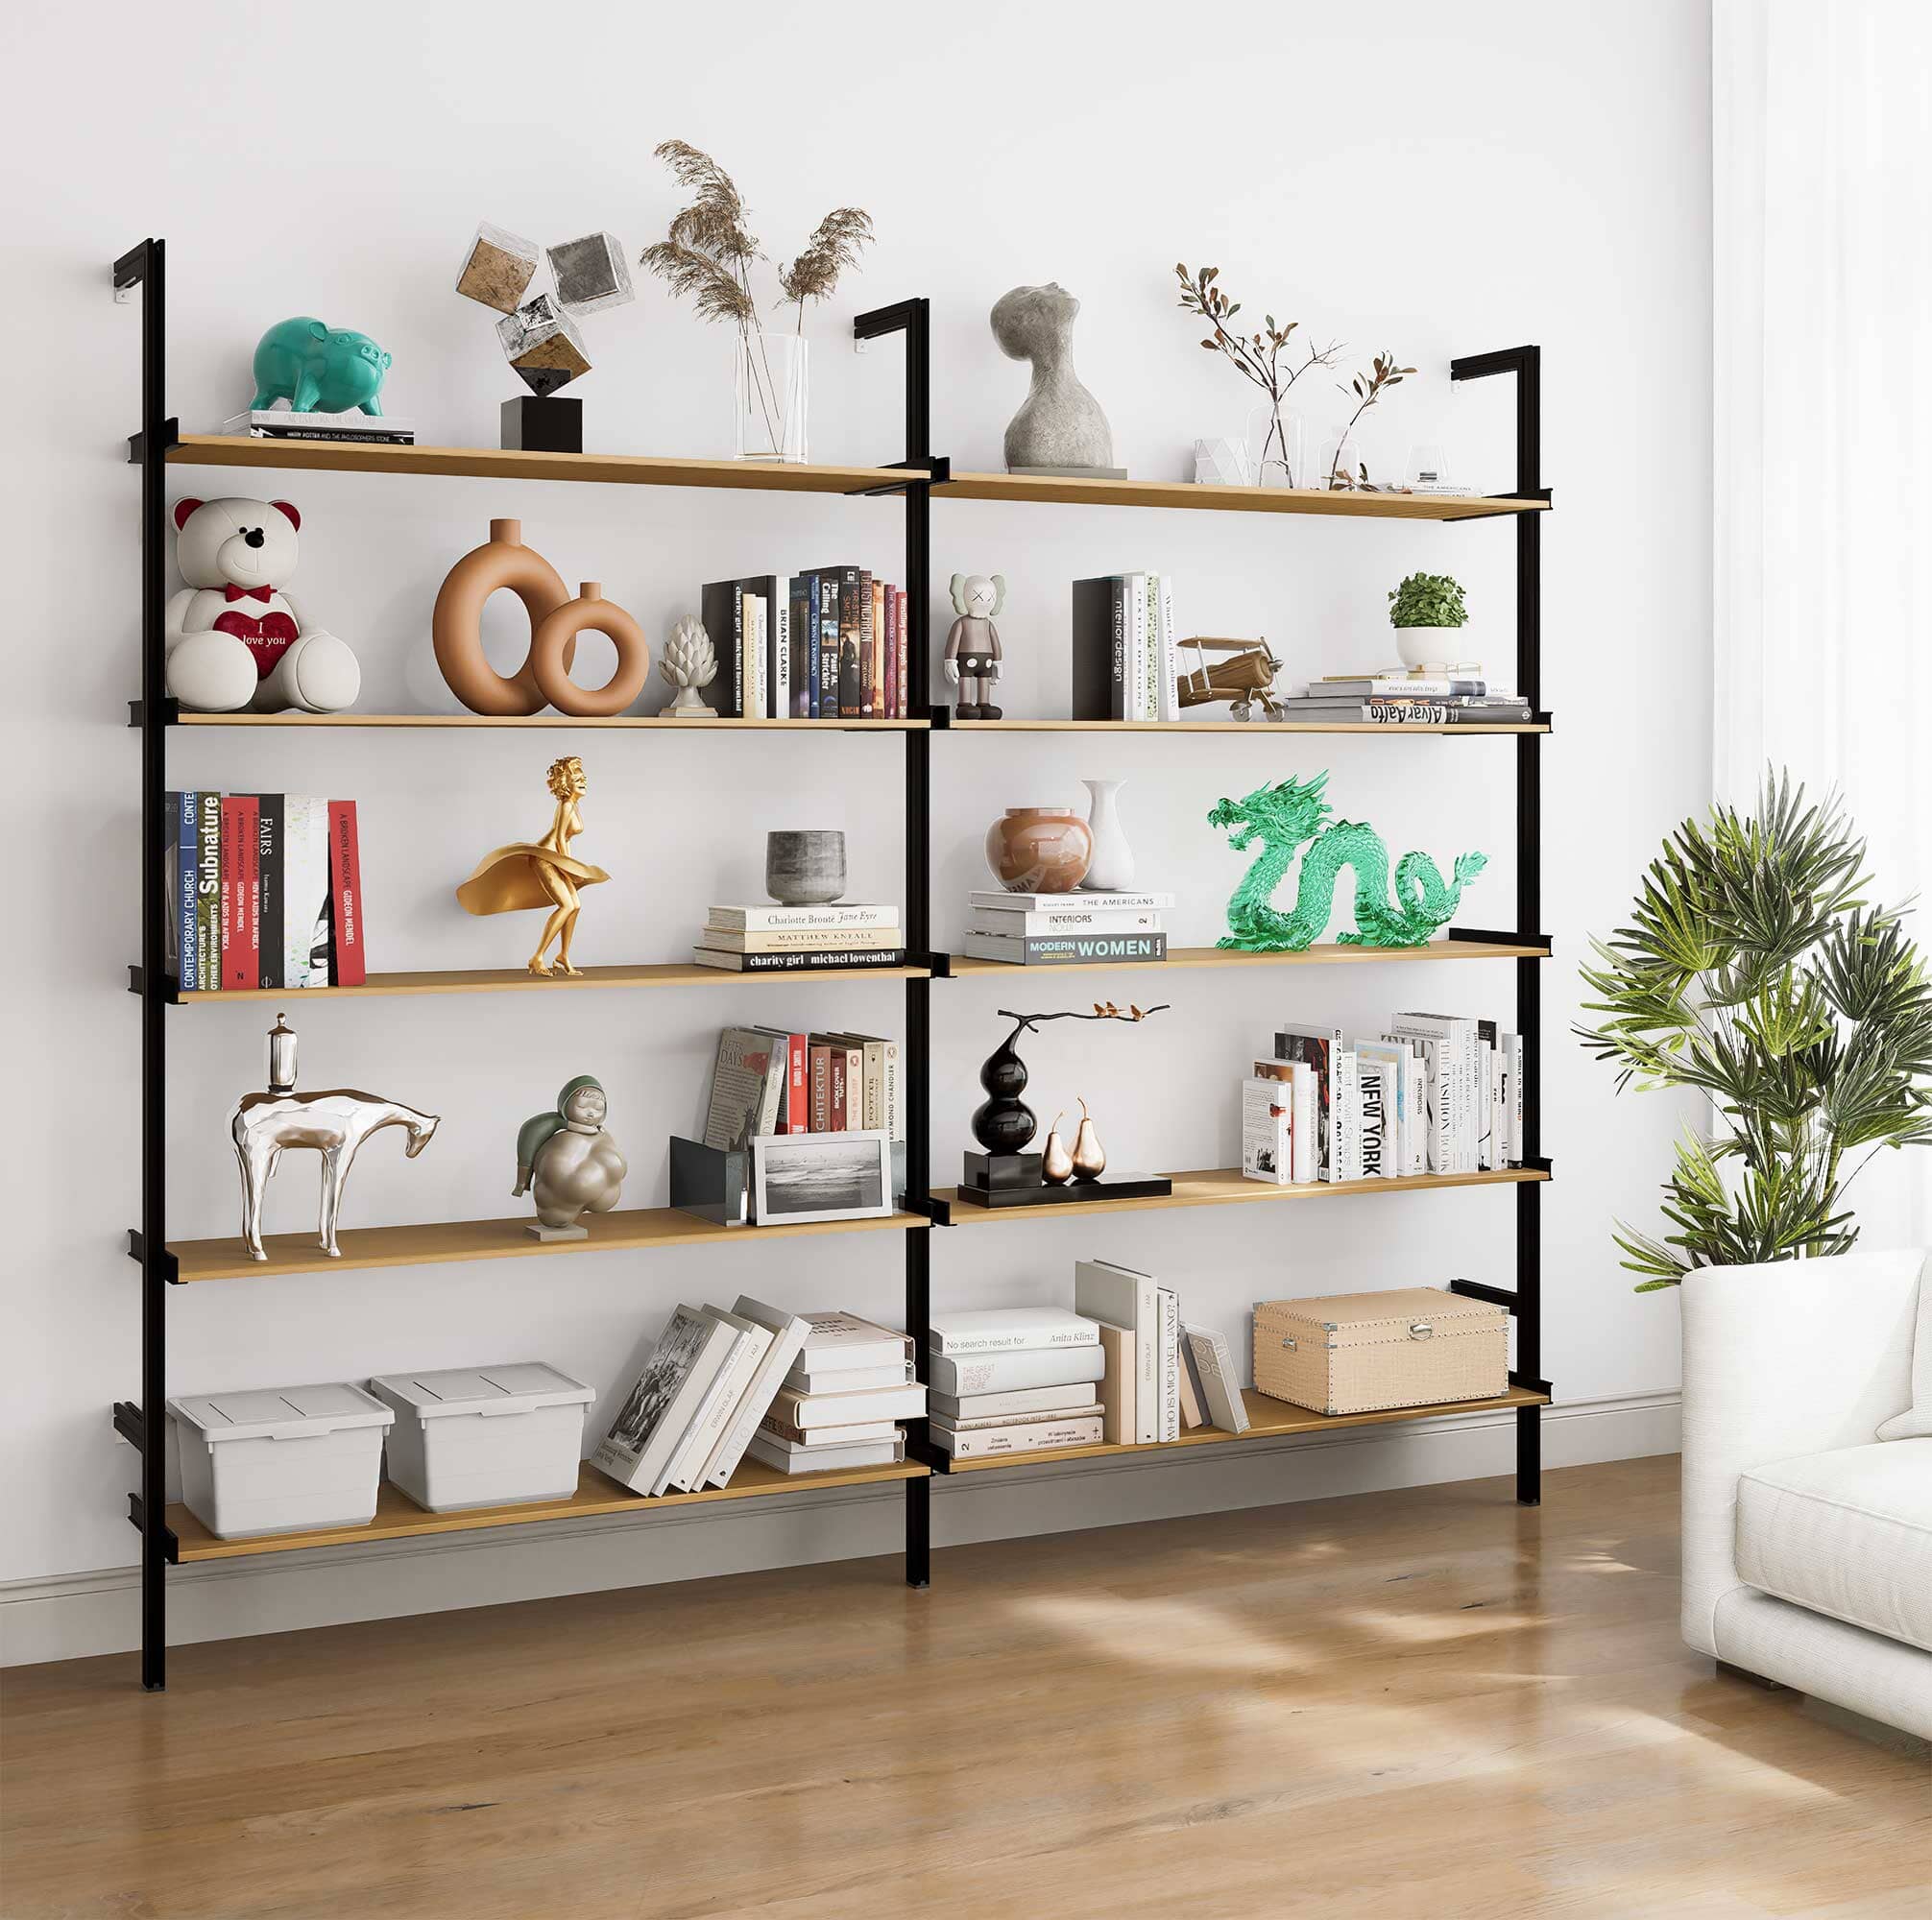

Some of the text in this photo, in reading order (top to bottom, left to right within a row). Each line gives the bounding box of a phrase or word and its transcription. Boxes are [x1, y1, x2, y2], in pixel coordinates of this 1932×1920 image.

[820, 583, 830, 614] Calling
[831, 583, 839, 600] The
[258, 621, 263, 634] I
[242, 634, 286, 647] love you
[780, 609, 788, 687] BRIAN CLARKE
[821, 652, 830, 691] Strickler
[1371, 706, 1443, 723] Alvar Aalto
[260, 817, 274, 855] FAIRS
[339, 821, 350, 849] BROKEN
[199, 796, 219, 895] Subnature
[343, 890, 353, 917] GIDEON
[767, 915, 806, 924] Charlotte
[837, 911, 858, 924] Jane
[859, 911, 877, 922] Eyre
[1050, 915, 1093, 924] INTERIORS
[183, 870, 195, 988] CONTEMPORARY CHURCH
[345, 917, 355, 946] MENDEL
[209, 903, 219, 991] OTHER ENVIRONMENTS
[1029, 942, 1075, 952] MODERN
[1077, 939, 1151, 956] WOMEN
[750, 951, 896, 968] charity girl michael lowenthal
[721, 1048, 743, 1068] DAYS
[1440, 1072, 1452, 1131] FASHION
[1361, 1074, 1381, 1176] NEW YORK
[1439, 1134, 1452, 1173] BOOK
[947, 1335, 1025, 1350] No search result for
[1049, 1332, 1095, 1343] Anita Klinz
[962, 1364, 996, 1376] THE GREAT
[982, 1374, 992, 1383] OF
[1166, 1304, 1175, 1442] WHO IS MICHAEL JANG?
[962, 1382, 986, 1392] FUTURE
[961, 1443, 970, 1452] 2
